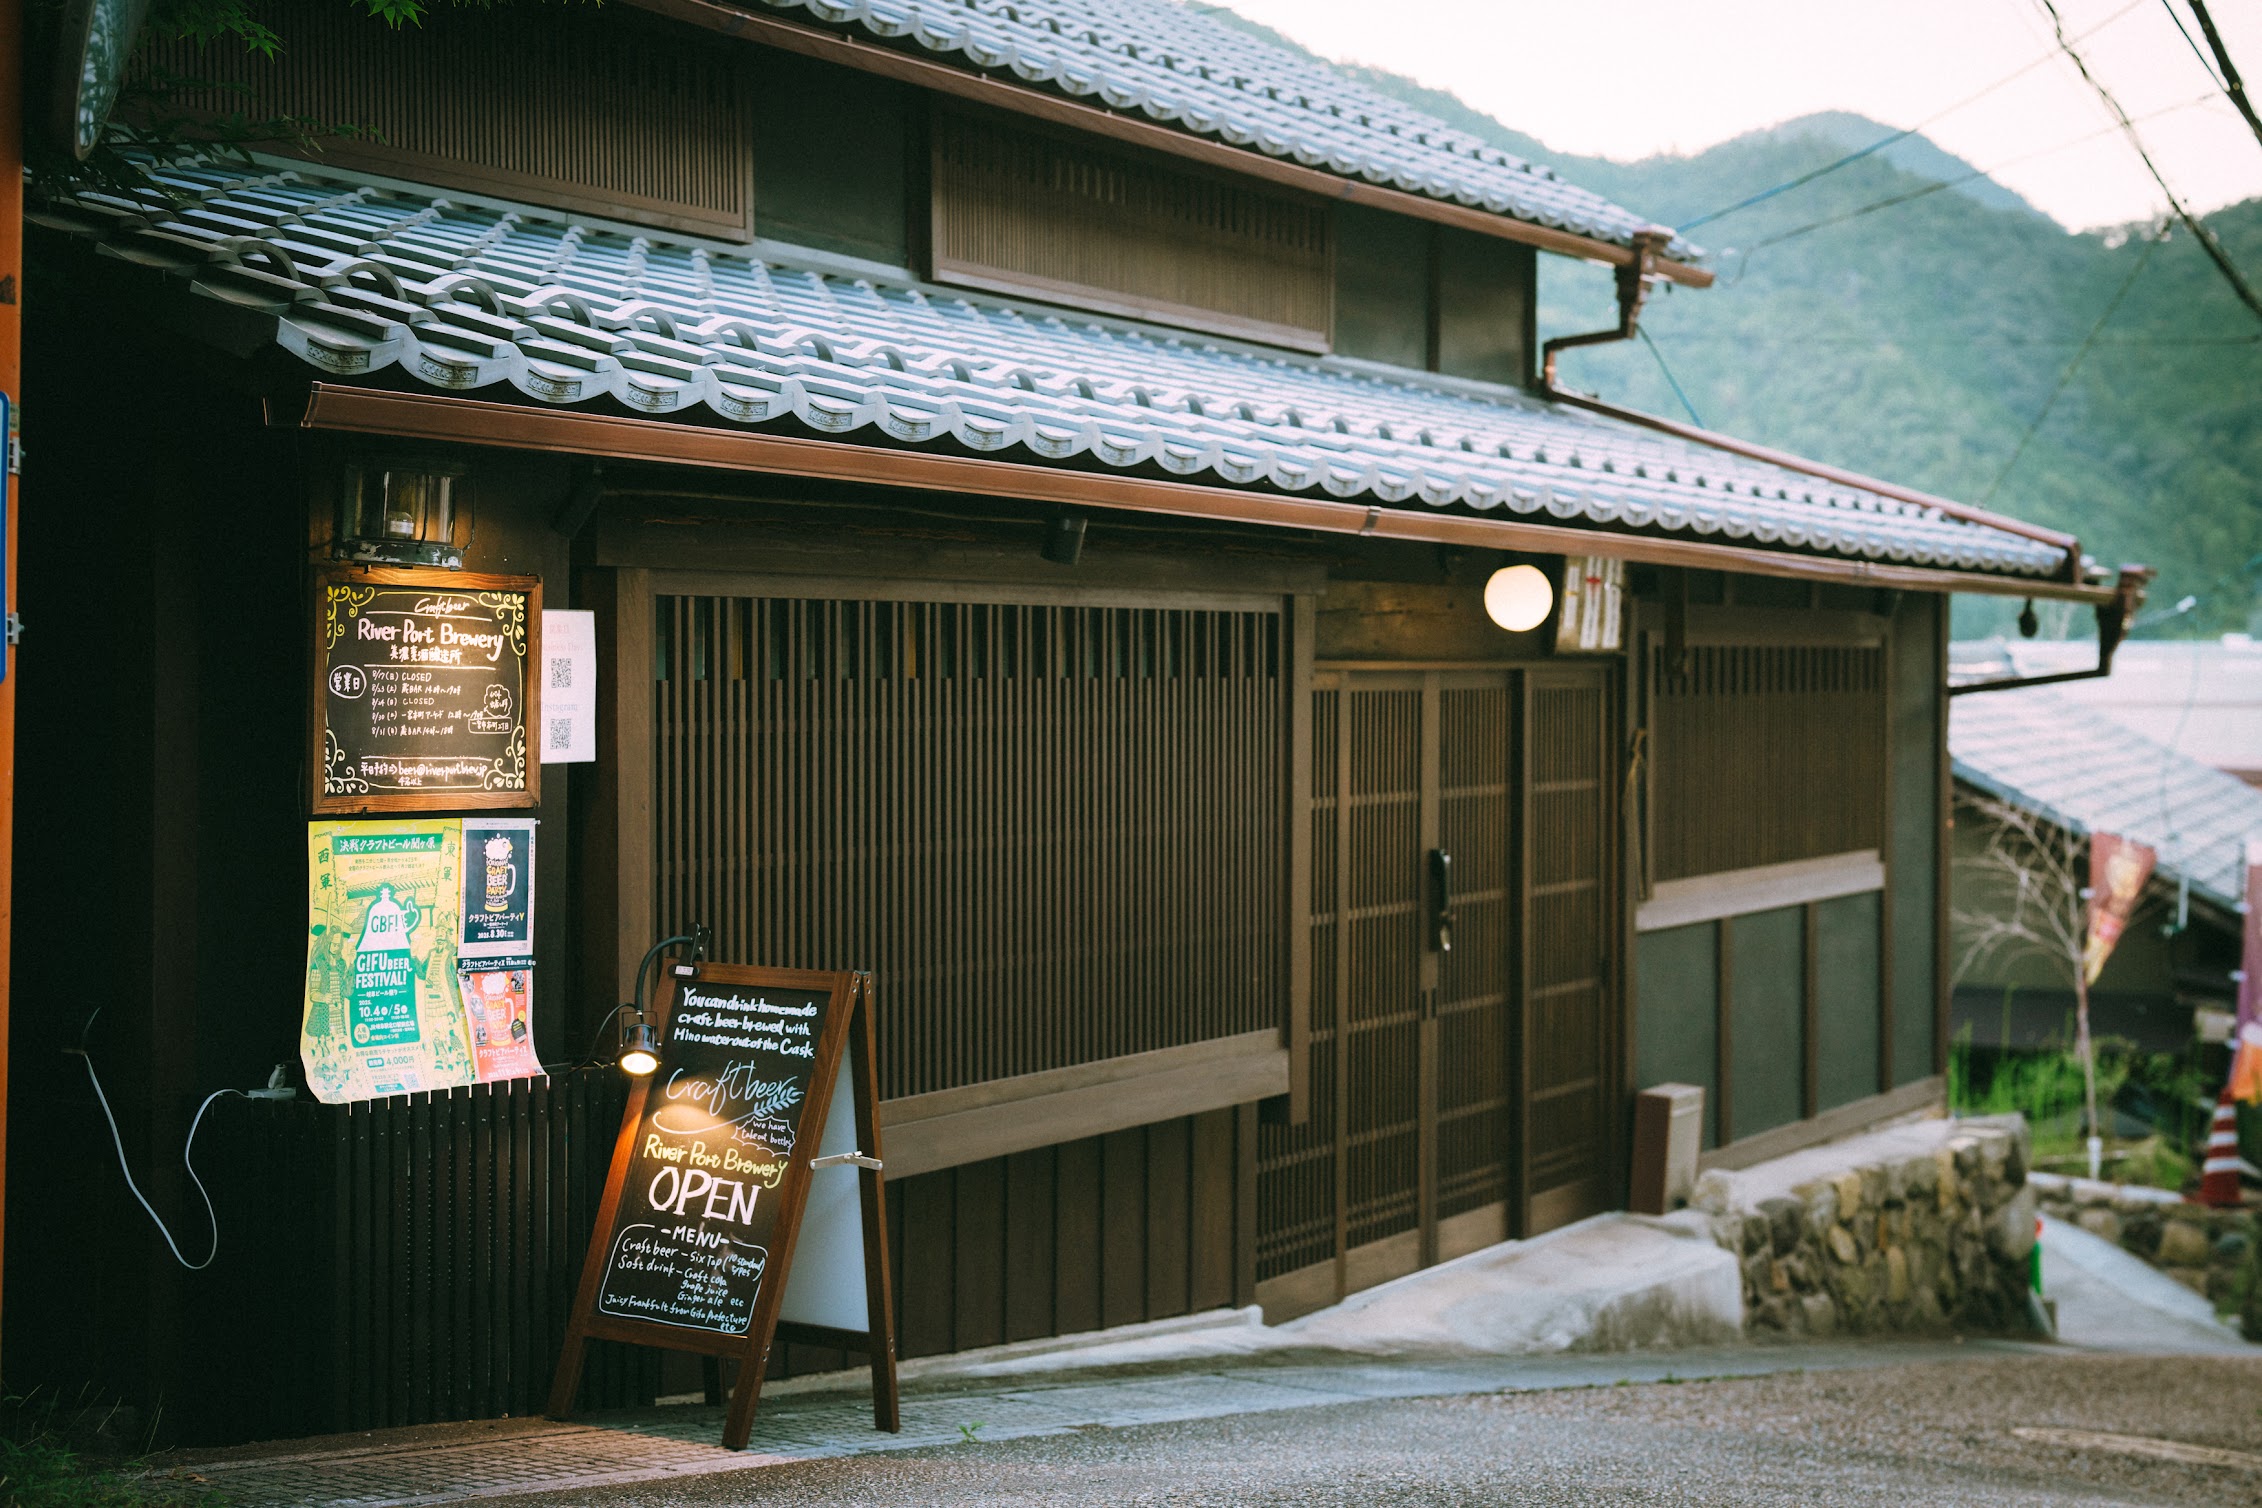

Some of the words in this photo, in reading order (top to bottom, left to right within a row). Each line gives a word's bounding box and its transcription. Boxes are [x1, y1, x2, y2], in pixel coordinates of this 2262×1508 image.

[358, 618, 401, 641] River
[402, 619, 435, 643] Port
[440, 623, 504, 661] Brewery
[334, 672, 360, 692] 営業日
[402, 672, 432, 682] CLOSED
[402, 698, 434, 706] CLOSED
[486, 866, 508, 876] CRAFT
[487, 874, 508, 886] BEER
[486, 885, 507, 896] PARTY
[371, 914, 398, 934] GBF!
[683, 986, 705, 1008] You
[704, 997, 727, 1010] can
[727, 994, 759, 1012] drink
[759, 998, 818, 1017] homemade
[678, 1012, 714, 1026] craft
[714, 1012, 742, 1028] beer
[742, 1016, 784, 1036] brewed
[786, 1022, 811, 1036] with
[674, 1027, 700, 1042] Mino
[702, 1032, 732, 1046] water
[732, 1034, 750, 1048] out
[750, 1038, 764, 1050] of
[762, 1038, 779, 1051] the
[780, 1038, 816, 1059] Cask.
[666, 1060, 747, 1116] Craft
[744, 1060, 798, 1100] beer
[768, 1120, 787, 1132] have
[643, 1134, 688, 1163] River
[690, 1140, 721, 1169] Port
[724, 1148, 788, 1189] Brewery
[648, 1166, 762, 1226] OPEN
[622, 1238, 652, 1254] Craft
[652, 1240, 678, 1258] beer
[690, 1250, 706, 1264] Six
[708, 1254, 722, 1270] Tap
[618, 1254, 644, 1270] Soft
[646, 1258, 676, 1278] drink
[685, 1268, 708, 1283] Craft
[710, 1276, 728, 1286] cola
[678, 1291, 706, 1304] Ginger
[707, 1296, 724, 1306] ale
[730, 1298, 745, 1306] etc
[680, 1280, 704, 1294] grape
[705, 1284, 728, 1297] juice
[605, 1294, 628, 1306] Juicy
[690, 1307, 706, 1318] Gifu
